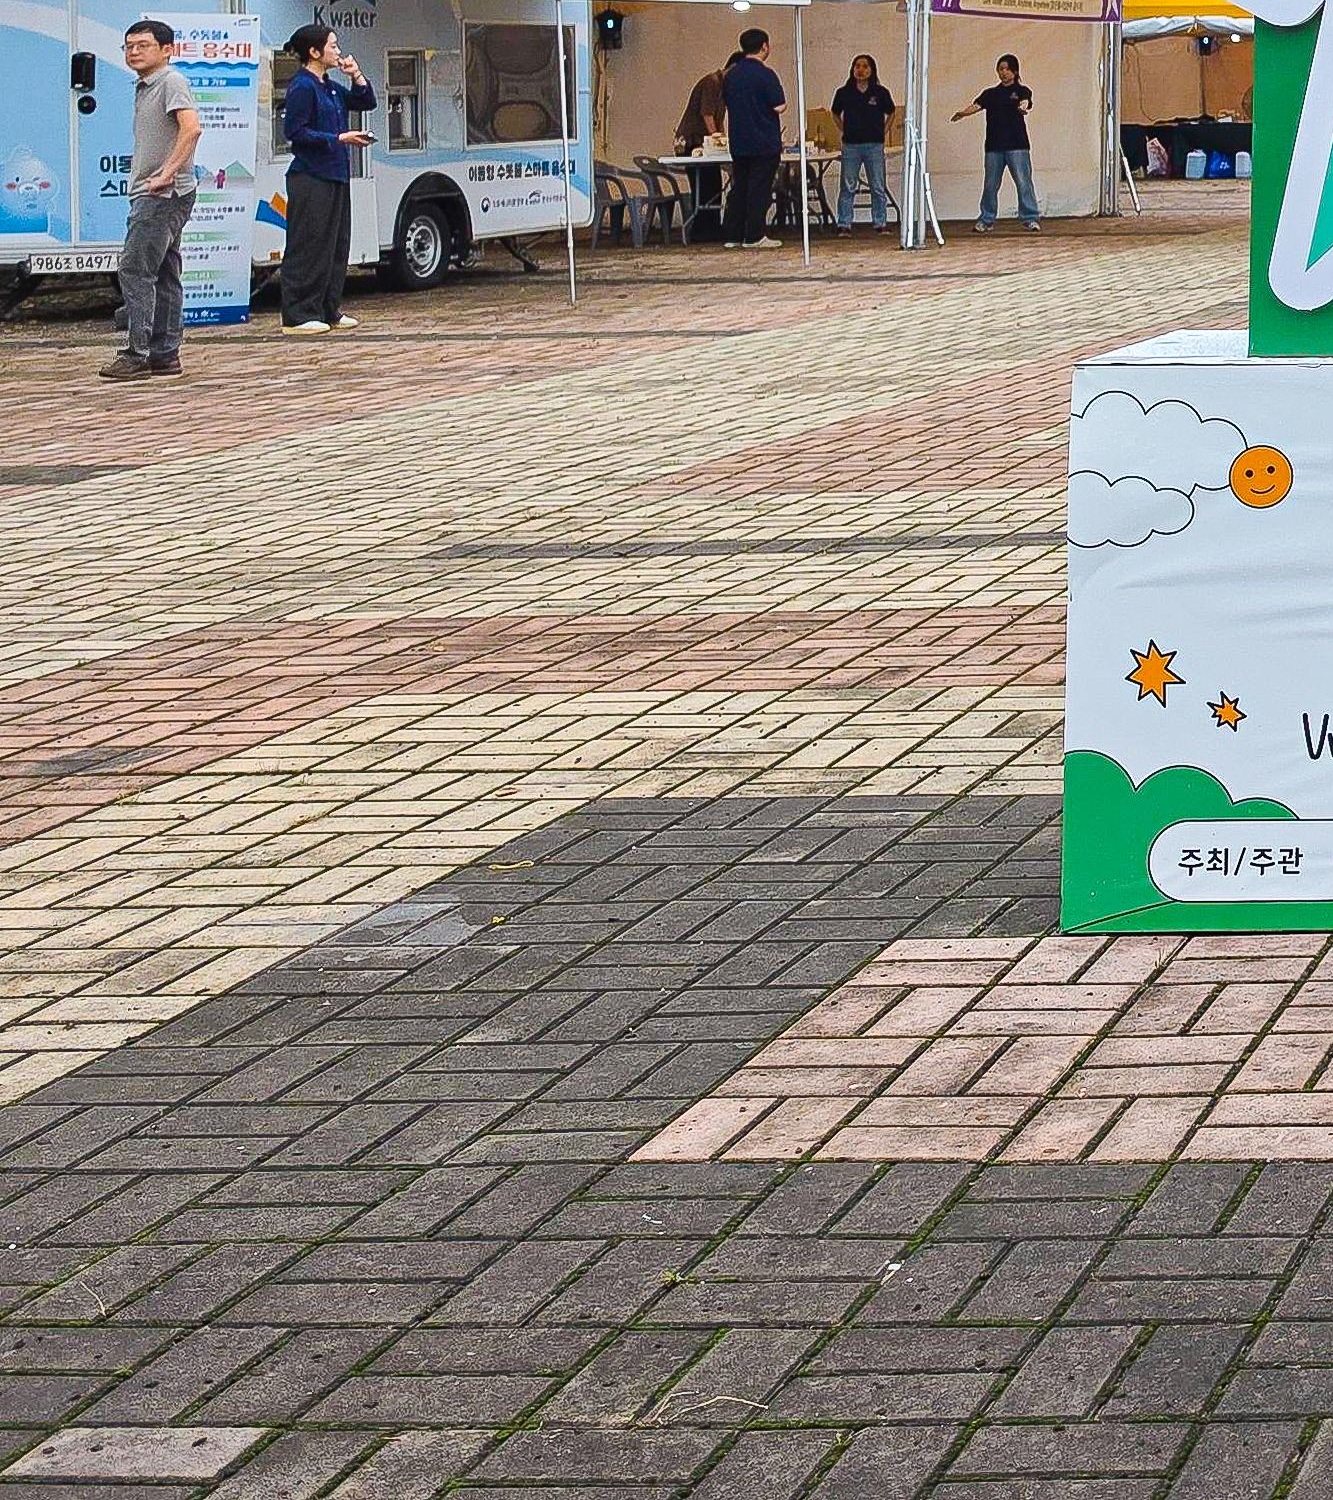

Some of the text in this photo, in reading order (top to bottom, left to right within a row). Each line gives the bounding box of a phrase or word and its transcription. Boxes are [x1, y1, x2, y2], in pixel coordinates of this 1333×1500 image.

[202, 42, 252, 59] 음수대
[100, 155, 133, 174] 이동
[75, 256, 112, 269] 8497
[1177, 846, 1304, 877] 주최/주관
